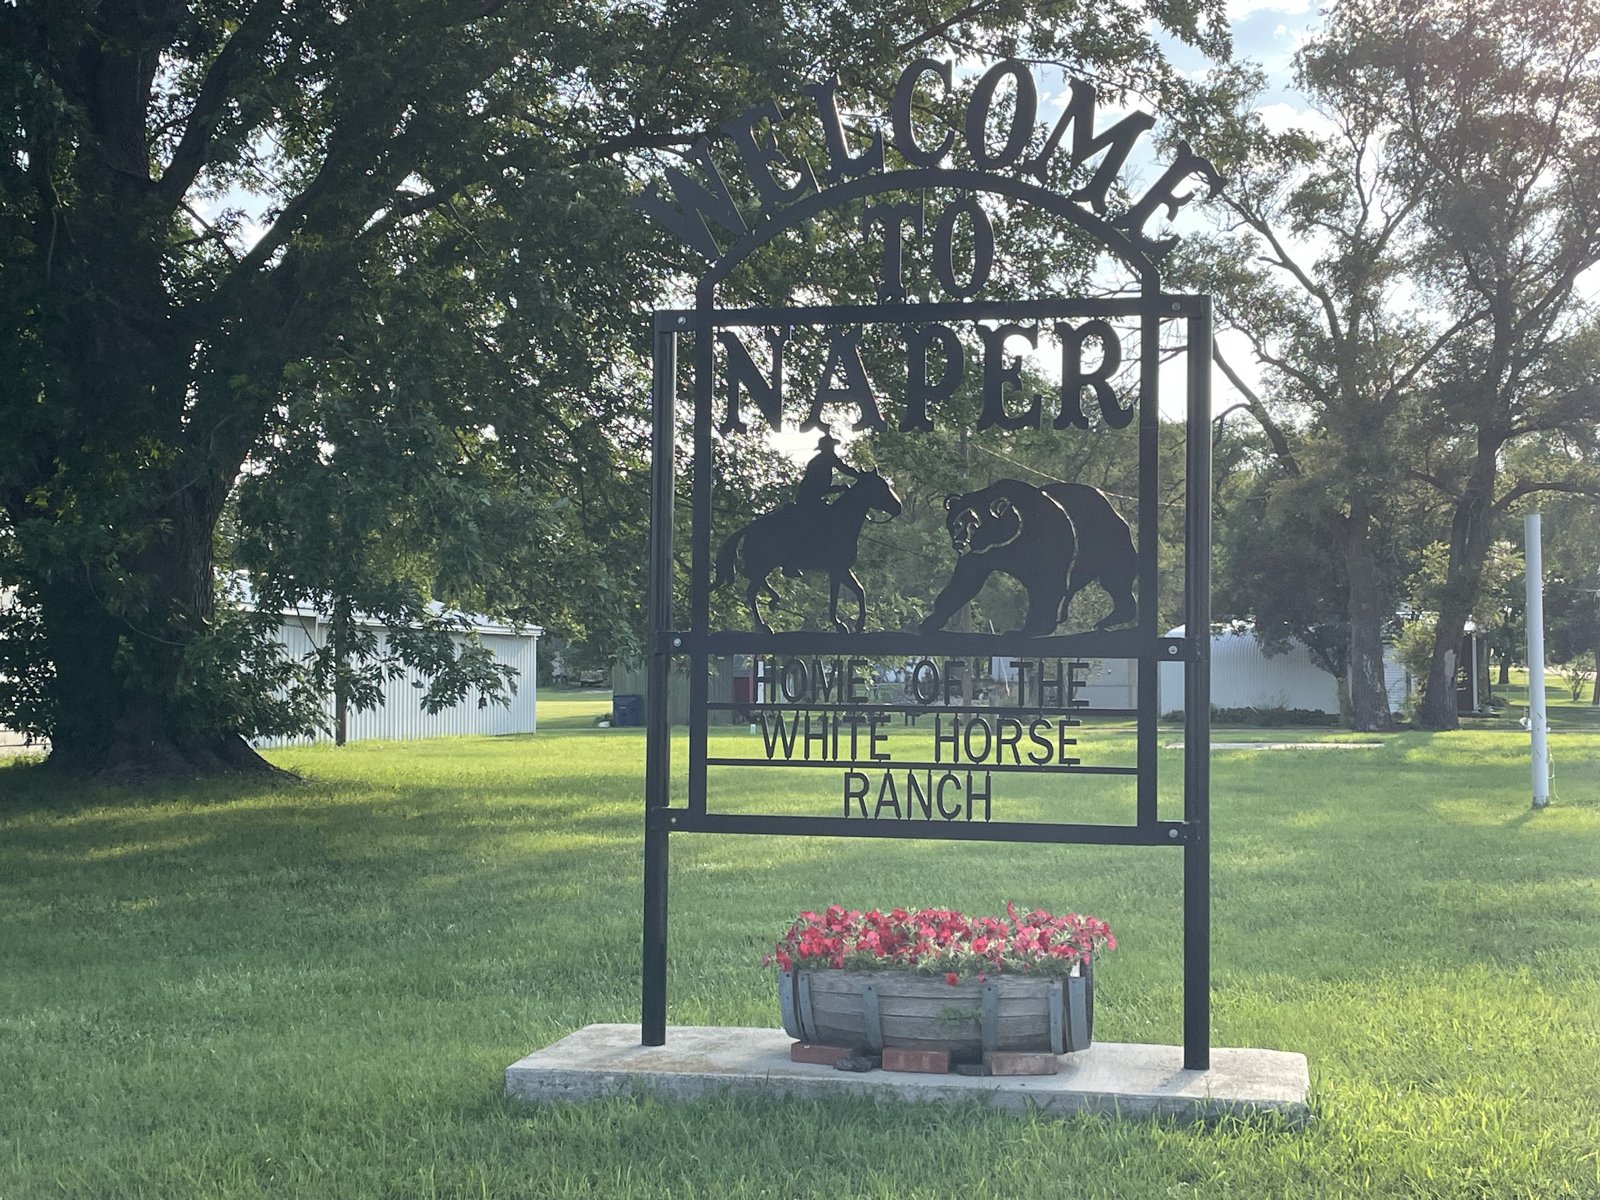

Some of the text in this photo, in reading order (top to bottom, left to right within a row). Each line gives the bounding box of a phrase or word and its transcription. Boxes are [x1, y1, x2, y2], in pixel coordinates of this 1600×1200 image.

[641, 57, 1228, 261] WELCOME
[862, 196, 995, 301] TO
[717, 319, 1134, 433] NAPER
[753, 658, 1090, 708] HOME OF THE
[761, 711, 1081, 765] WHITE HORSE
[844, 771, 992, 821] RANCH
